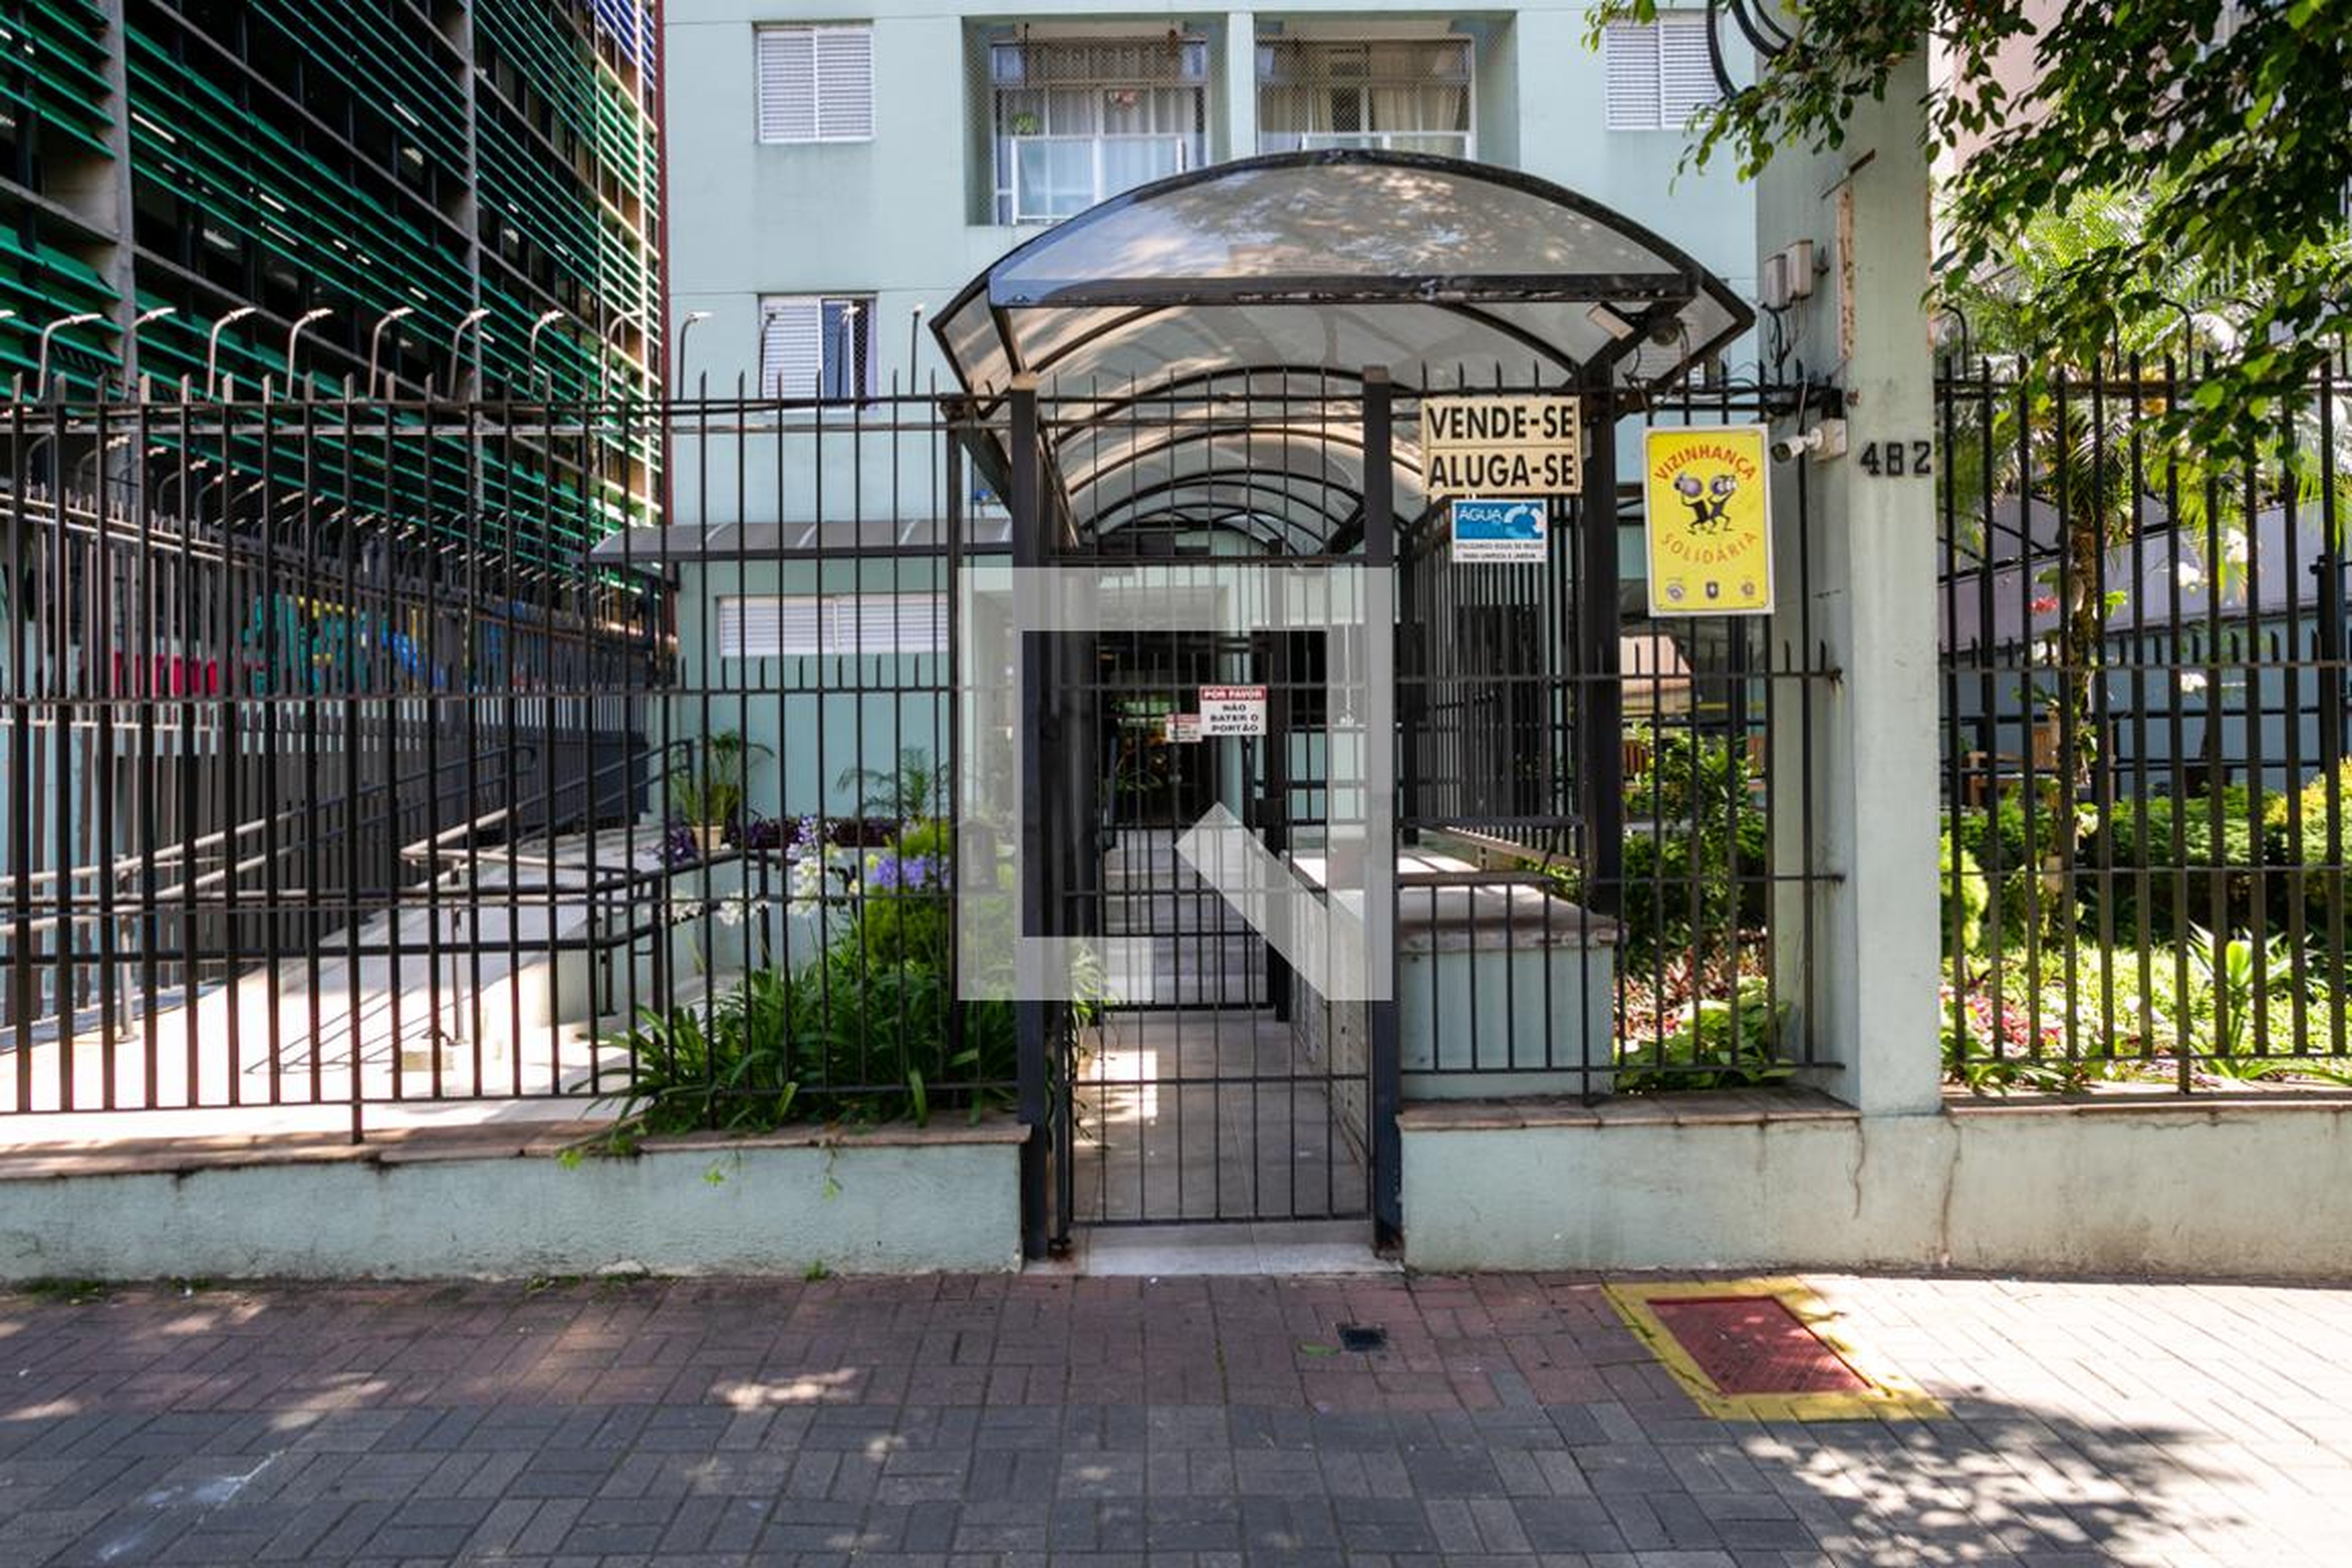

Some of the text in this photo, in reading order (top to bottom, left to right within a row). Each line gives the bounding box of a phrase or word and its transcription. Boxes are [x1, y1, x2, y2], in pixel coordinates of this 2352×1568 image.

[1428, 405, 1574, 439] VENDE-SE
[1429, 454, 1574, 488] ALUGA-SE
[1654, 444, 1757, 481] VIZINHANÇA
[1860, 440, 1932, 477] 482
[1458, 506, 1502, 521] ÁGUA
[1204, 689, 1262, 699] POR FAVOR
